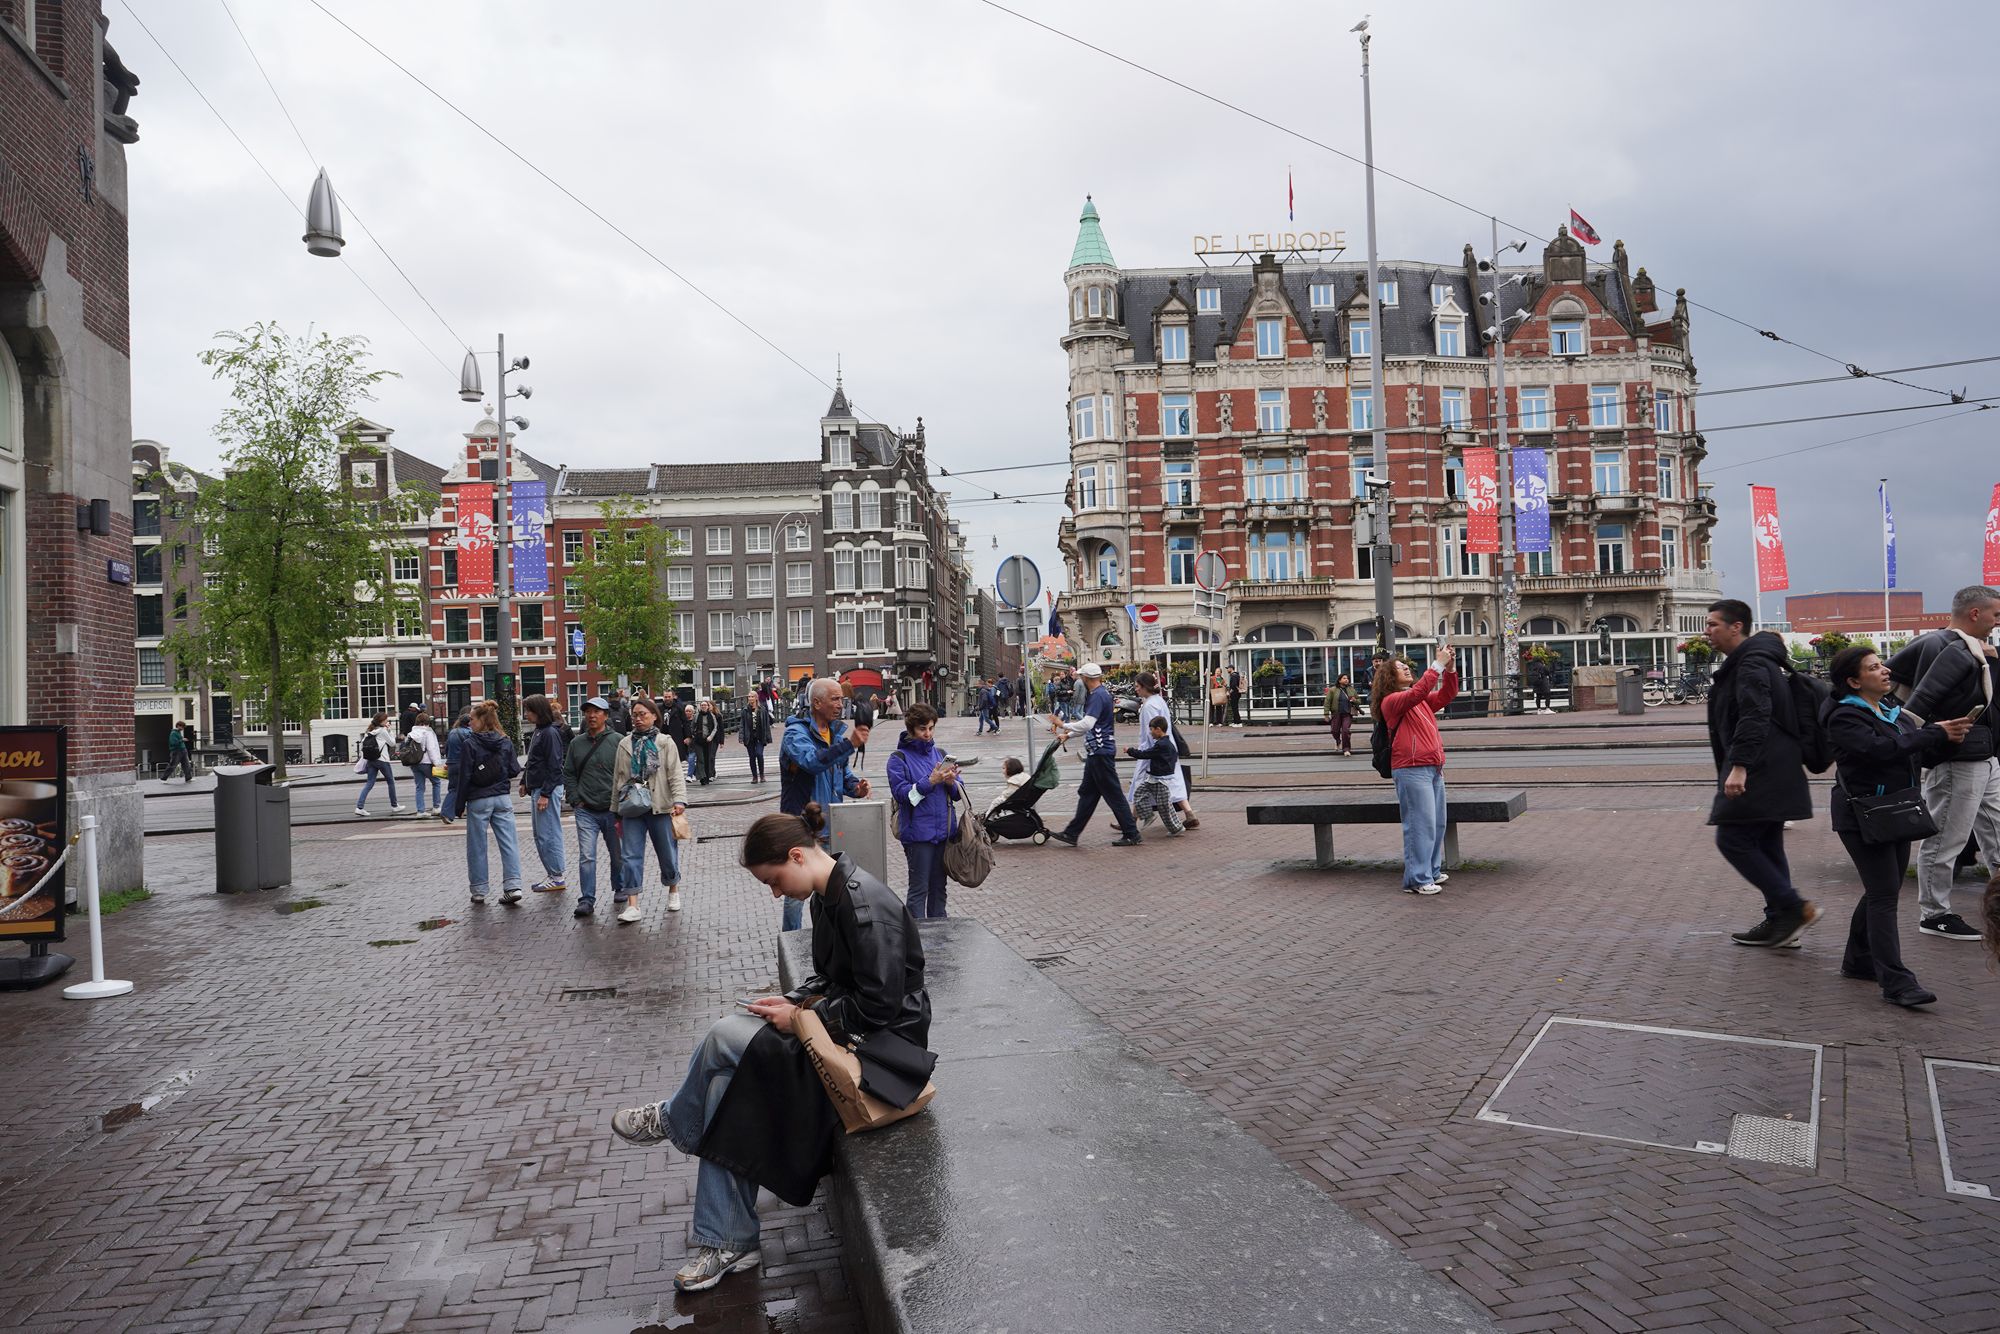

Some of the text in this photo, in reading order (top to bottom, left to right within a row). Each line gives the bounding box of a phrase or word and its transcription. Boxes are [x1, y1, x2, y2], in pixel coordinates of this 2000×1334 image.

[1194, 231, 1346, 253] DE L'EUROPE
[803, 1036, 847, 1103] lush.com
